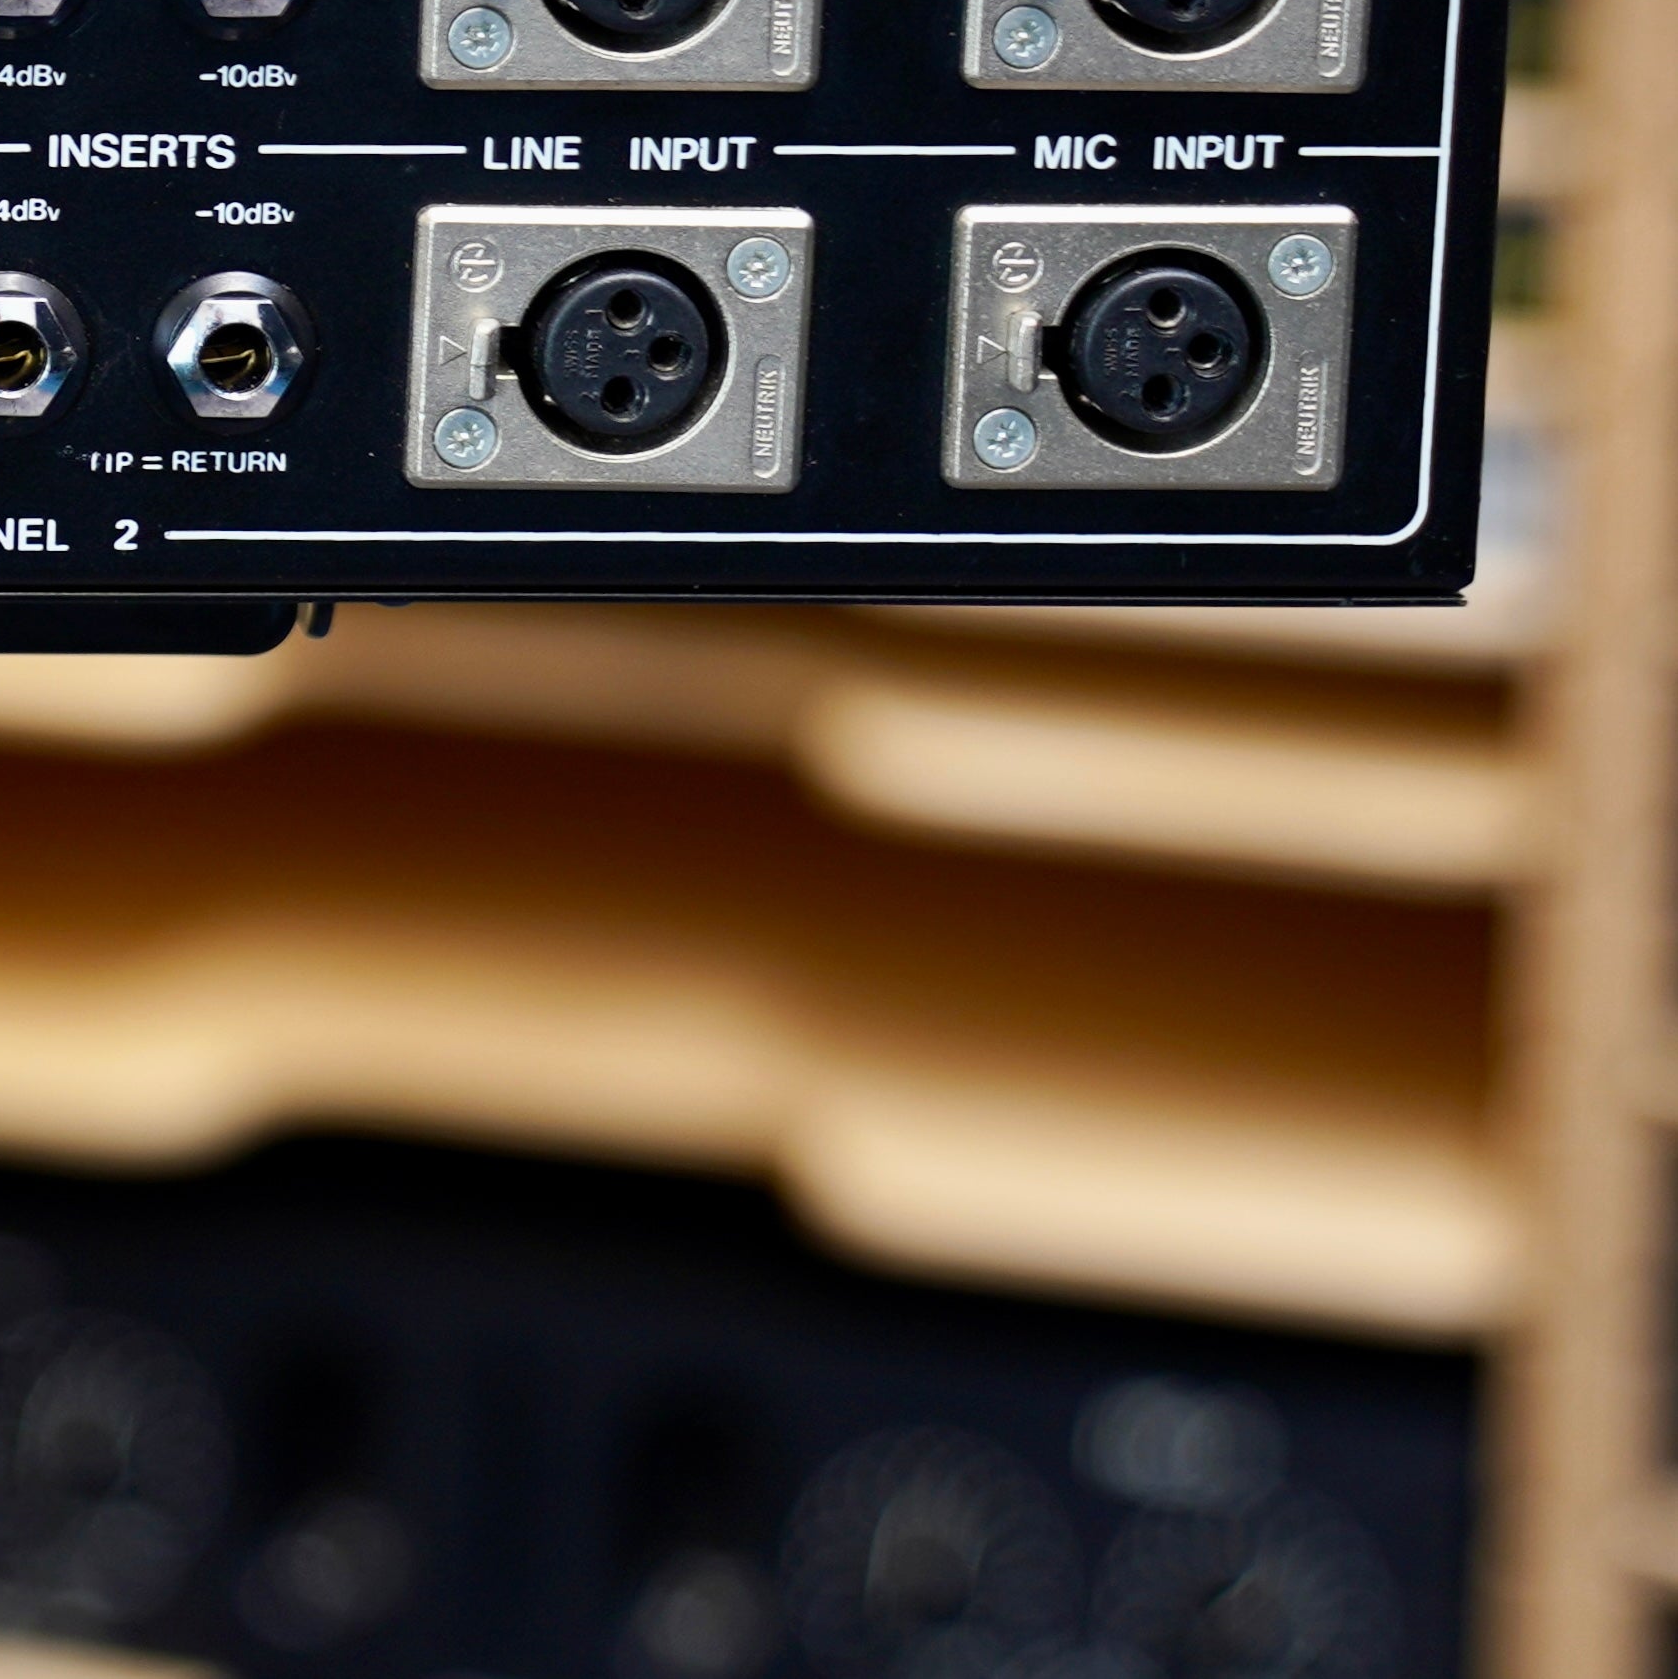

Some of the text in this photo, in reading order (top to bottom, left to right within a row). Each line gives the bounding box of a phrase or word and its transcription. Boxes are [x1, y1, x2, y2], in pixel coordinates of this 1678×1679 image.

[49, 133, 235, 169] INSERTS
[484, 136, 757, 171] LINE INPUT
[1035, 134, 1284, 170] MIC INPUT
[755, 369, 778, 458] NEUTRIK
[1297, 367, 1319, 456] NEUTRIK
[172, 451, 286, 473] RETURN
[114, 519, 138, 550] 2
